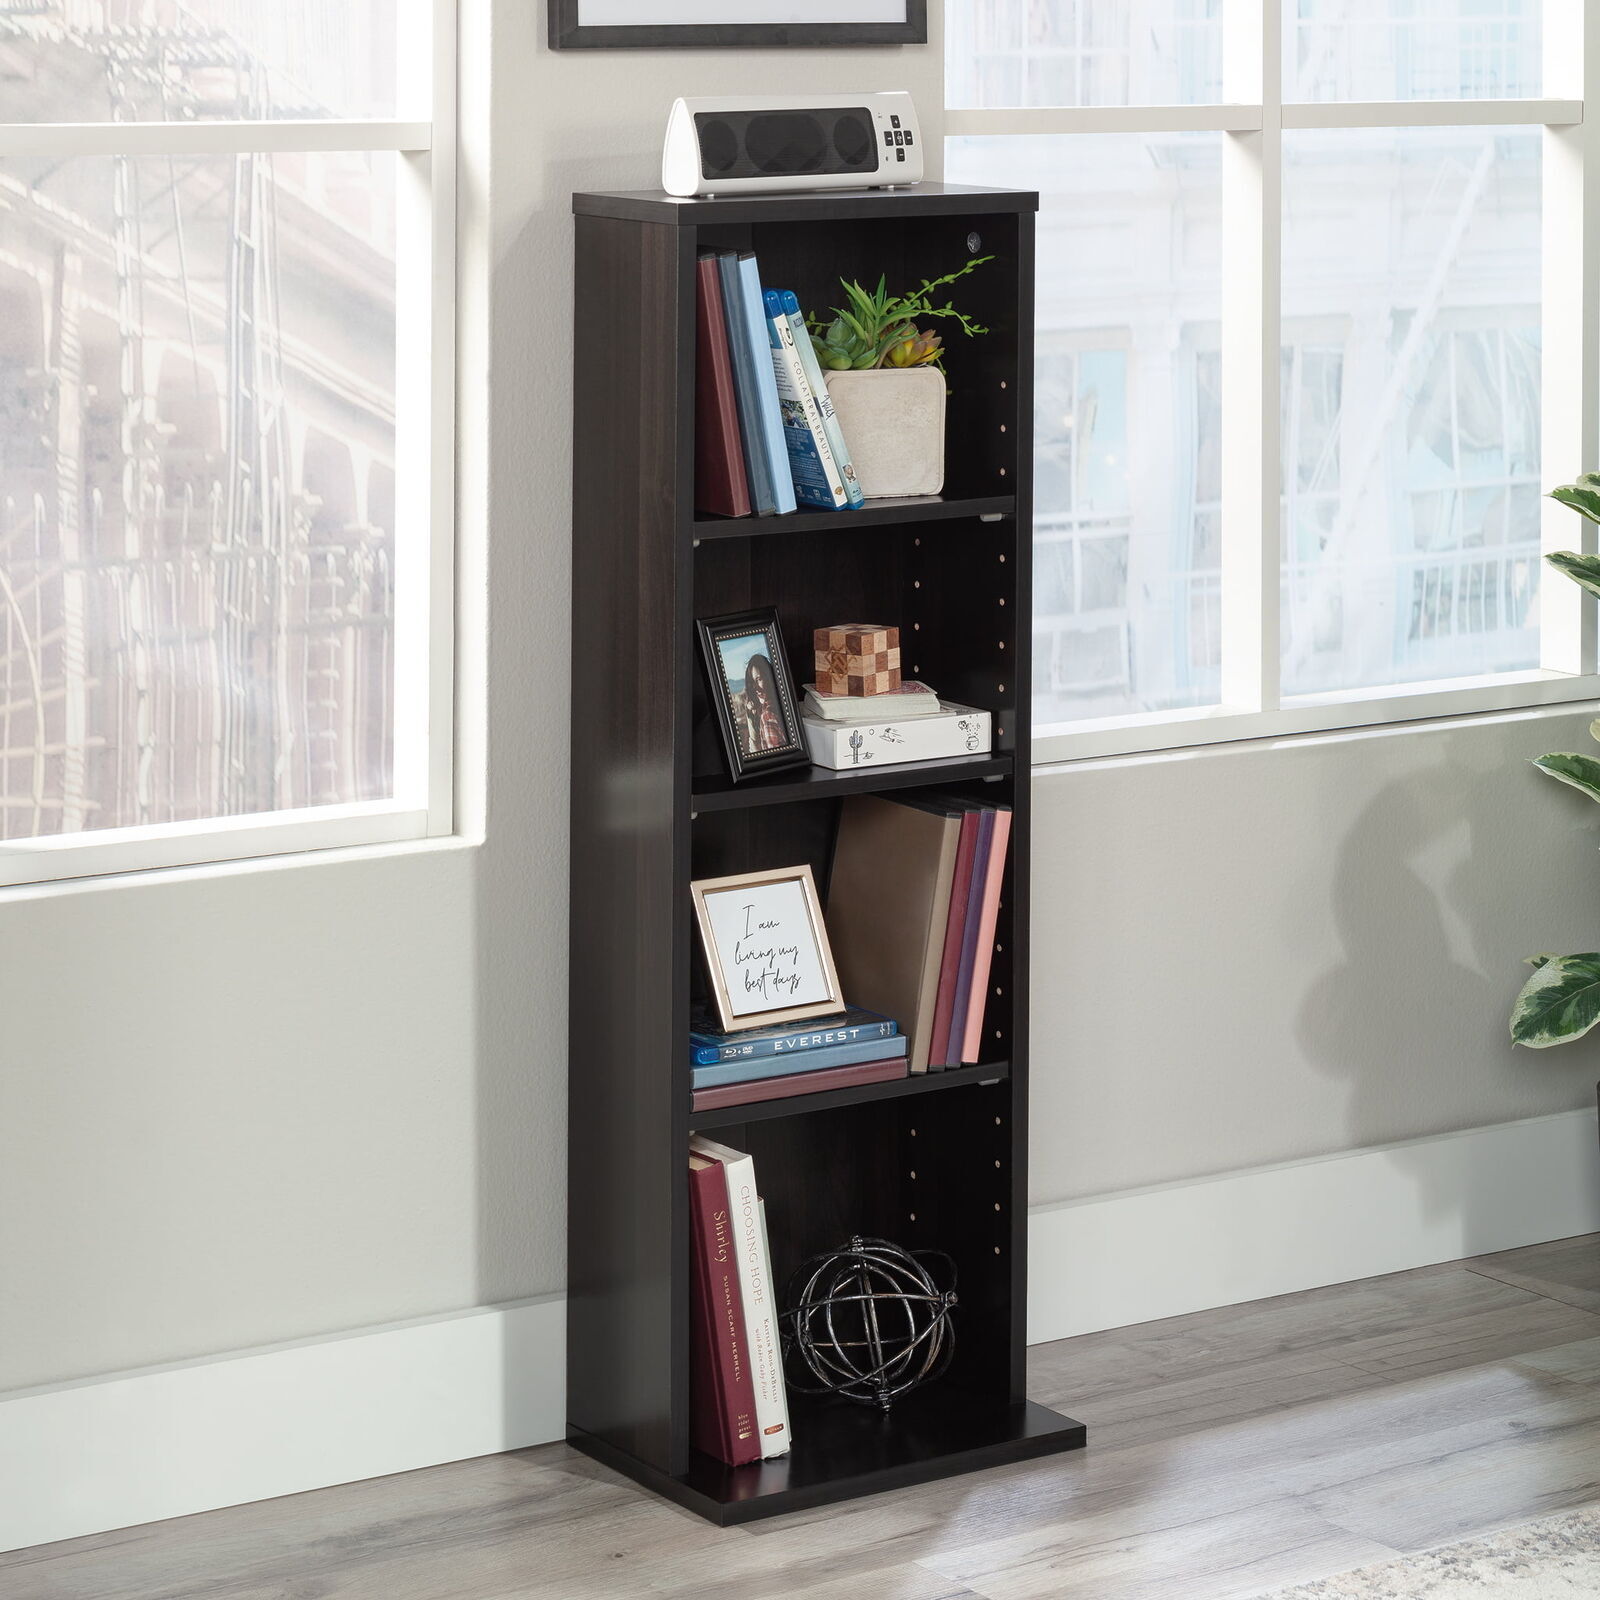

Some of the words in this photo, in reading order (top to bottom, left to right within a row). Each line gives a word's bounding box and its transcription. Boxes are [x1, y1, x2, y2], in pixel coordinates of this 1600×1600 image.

[793, 361, 818, 422] COLLATERAL
[814, 424, 831, 460] BEAUTY
[742, 904, 755, 940] I
[758, 920, 780, 929] am
[734, 941, 776, 968] living
[779, 945, 799, 965] my
[745, 967, 776, 1000] best
[772, 967, 801, 994] days
[774, 1029, 860, 1051] EVEREST
[713, 1210, 730, 1262] Shirley
[740, 1185, 758, 1263] CHOOSING
[750, 1266, 764, 1305] HOPE
[723, 1275, 732, 1306] SUSAN
[727, 1308, 736, 1337] SCARF
[731, 1341, 741, 1382] MERRELL
